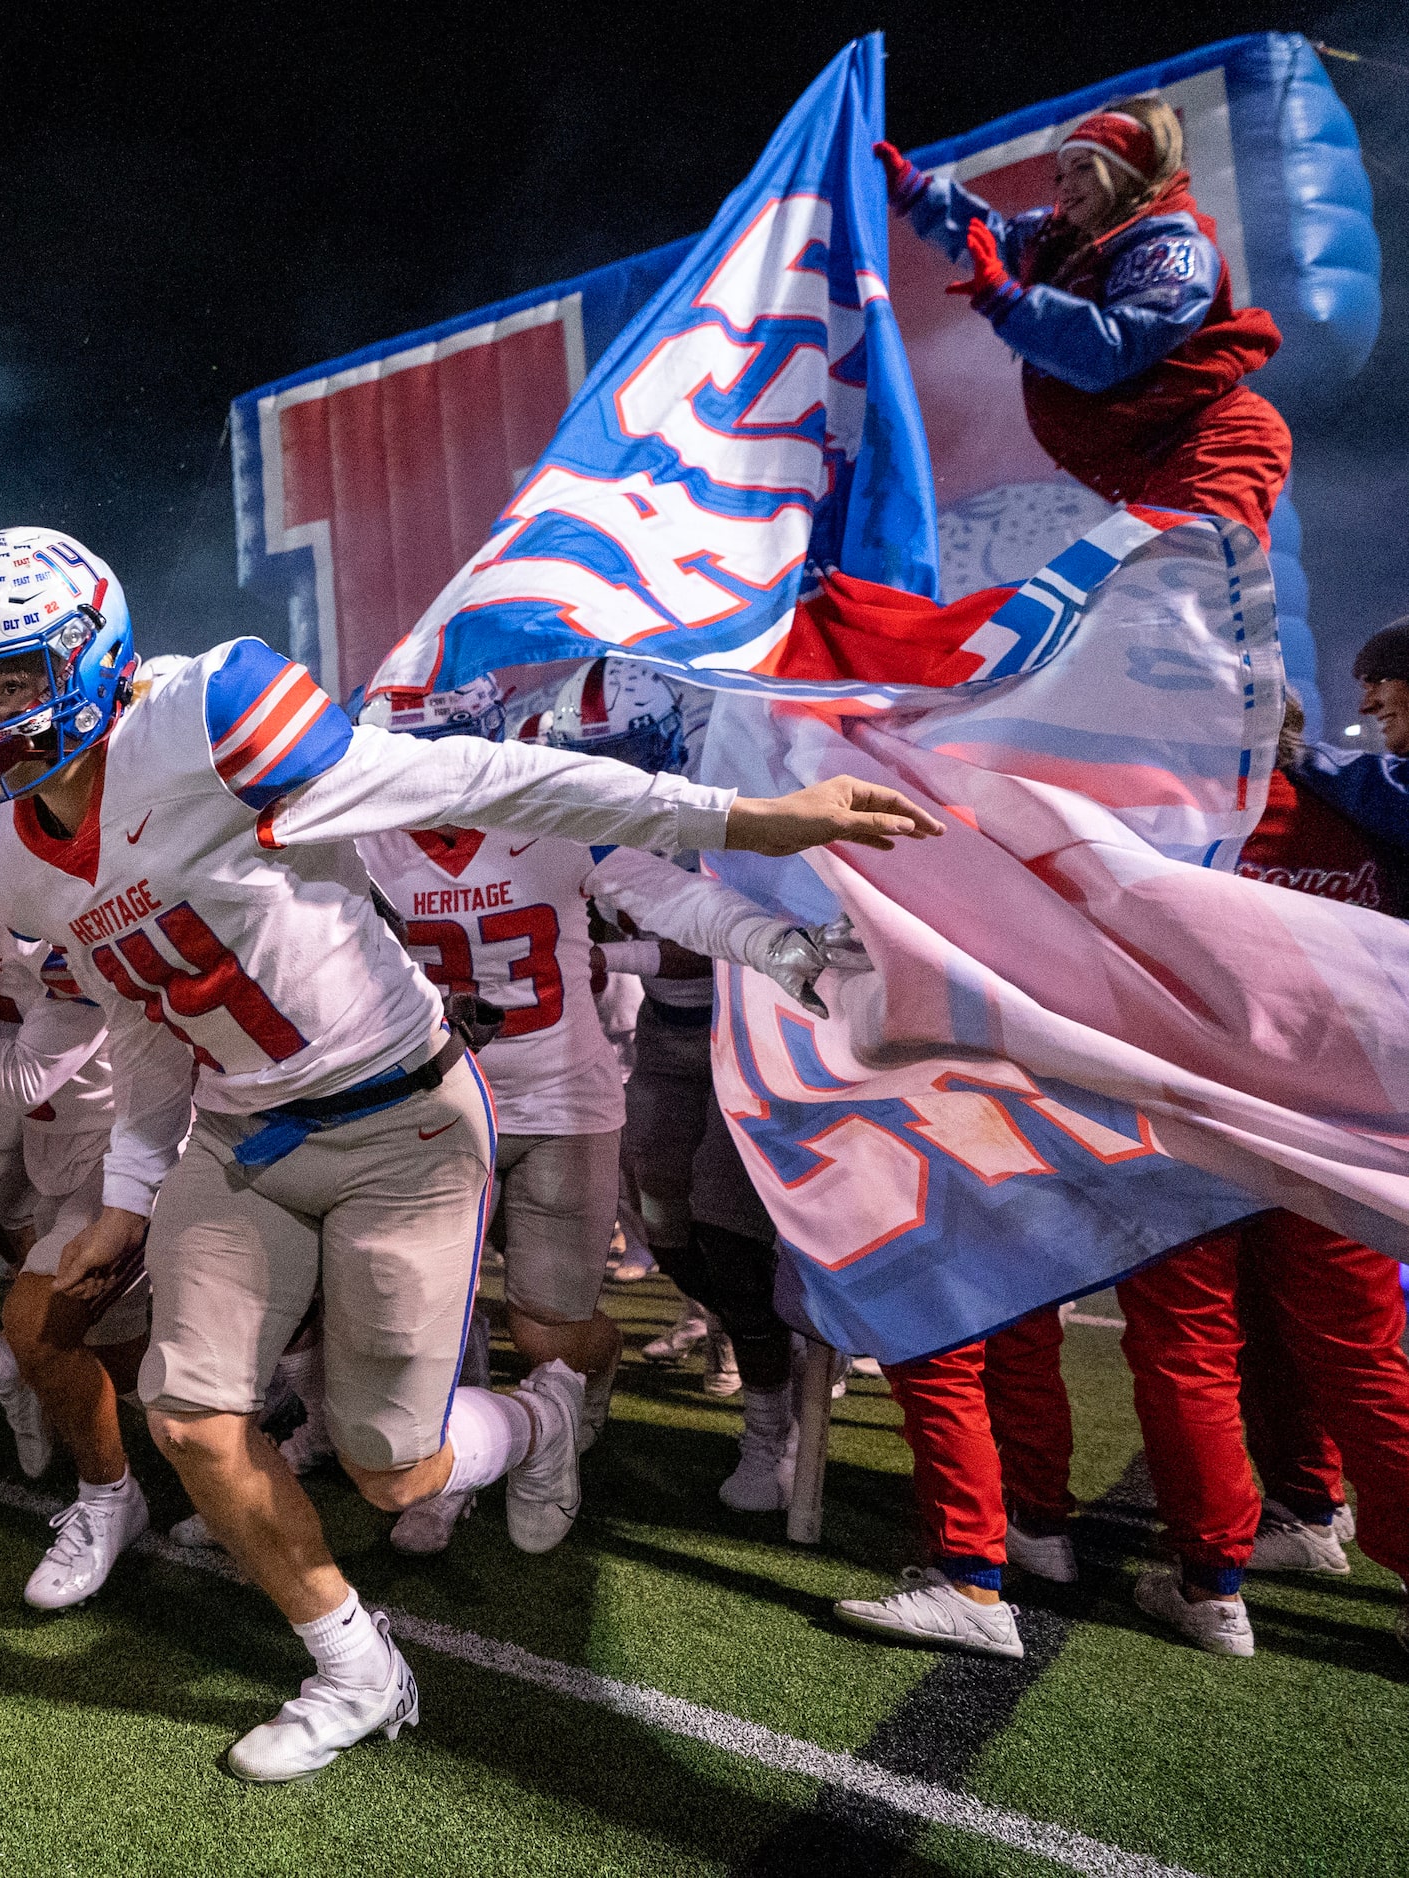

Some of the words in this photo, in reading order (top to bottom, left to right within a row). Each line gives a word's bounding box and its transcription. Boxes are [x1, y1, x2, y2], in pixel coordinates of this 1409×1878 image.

[13, 557, 31, 568] FEAST
[32, 541, 101, 598] 14
[12, 575, 30, 588] FEAST
[23, 612, 40, 626] DLT
[44, 600, 60, 615] 22
[69, 878, 163, 947] HERITAGE
[413, 880, 514, 916] HERITAGE
[91, 900, 310, 1075] 14
[404, 902, 565, 1039] 33
